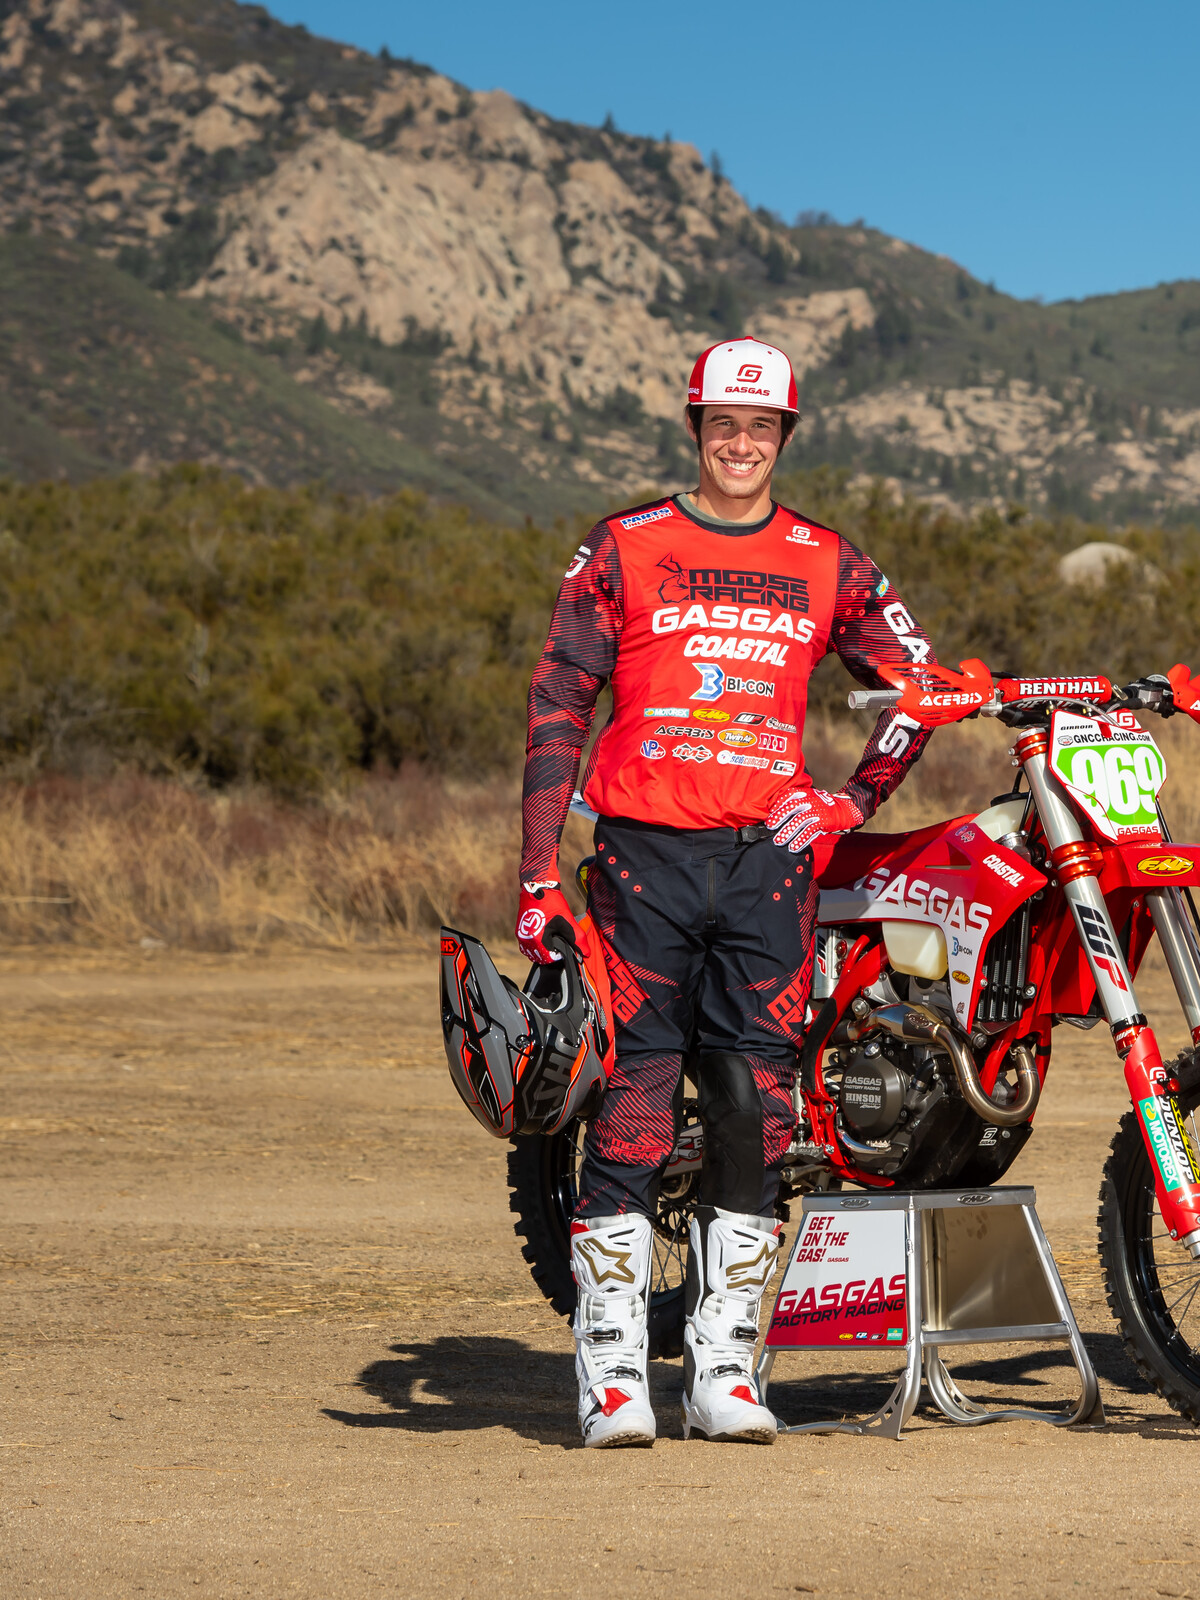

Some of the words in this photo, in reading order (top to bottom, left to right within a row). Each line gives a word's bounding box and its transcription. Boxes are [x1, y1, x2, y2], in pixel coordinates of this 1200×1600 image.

[725, 386, 770, 396] GASGAS
[621, 508, 670, 525] PARTS
[785, 535, 819, 547] GASGAS
[689, 569, 808, 595] MOOSE
[690, 585, 809, 613] RACING
[652, 604, 816, 644] GASGAS
[683, 634, 789, 667] COASTAL
[1019, 681, 1105, 695] RENTHAL
[654, 708, 688, 717] MOTOREX
[724, 732, 741, 742] Twin
[740, 734, 753, 743] Air
[676, 748, 709, 758] IMS
[1071, 746, 1159, 816] 969
[1118, 826, 1159, 835] GASGAS
[982, 854, 1025, 887] COASTAL
[1138, 856, 1194, 872] FMF
[861, 867, 993, 932] GASGAS
[845, 1076, 883, 1086] GASGAS
[845, 1092, 882, 1104] HINSON
[1159, 1096, 1195, 1184] DUNLOP
[1148, 1119, 1179, 1186] MOTOREX
[808, 1216, 835, 1231] GET
[802, 1233, 821, 1246] ON
[823, 1232, 850, 1247] THE
[796, 1248, 828, 1263] GAS!
[778, 1274, 906, 1313] GASGAS
[771, 1307, 844, 1330] FACTORY
[844, 1298, 906, 1319] RACING
